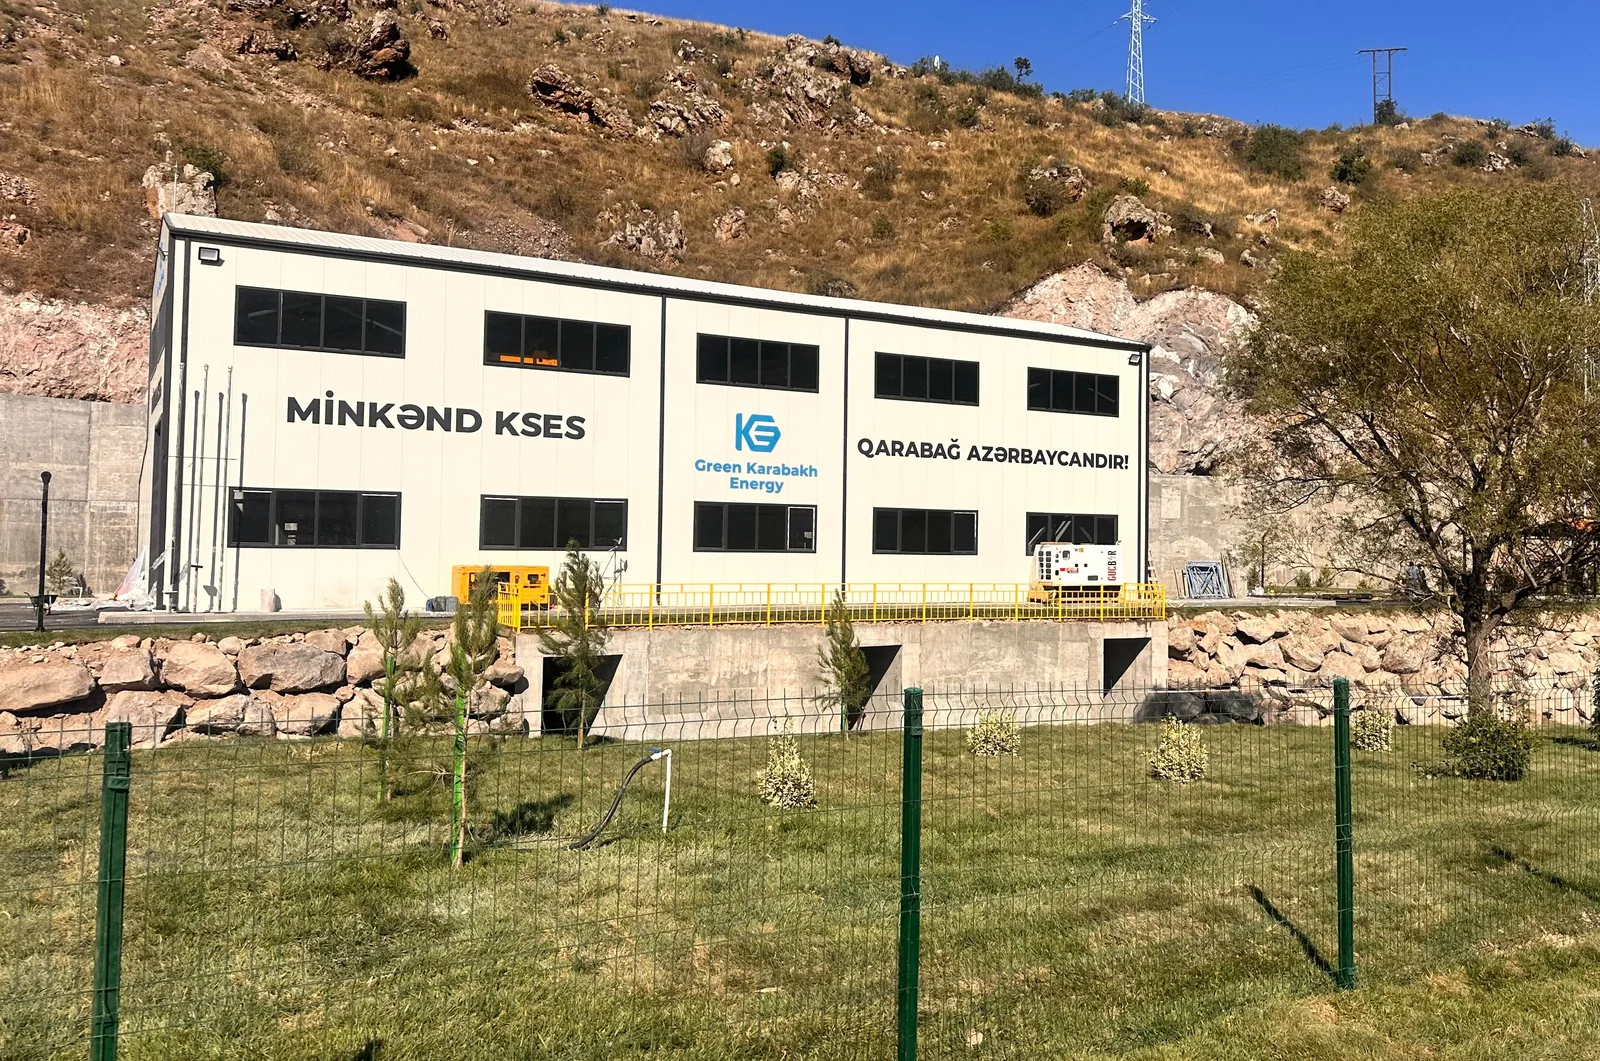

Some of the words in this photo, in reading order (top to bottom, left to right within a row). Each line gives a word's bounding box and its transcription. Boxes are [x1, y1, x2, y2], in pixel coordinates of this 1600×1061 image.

[287, 390, 483, 433] MİNKƏND
[495, 410, 586, 440] KSES
[857, 438, 961, 460] QARABAĞ
[966, 445, 1129, 470] AZƏRBAYCANDIR!
[694, 459, 742, 473] Green
[746, 462, 818, 477] Karabakh
[729, 477, 784, 494] Energy
